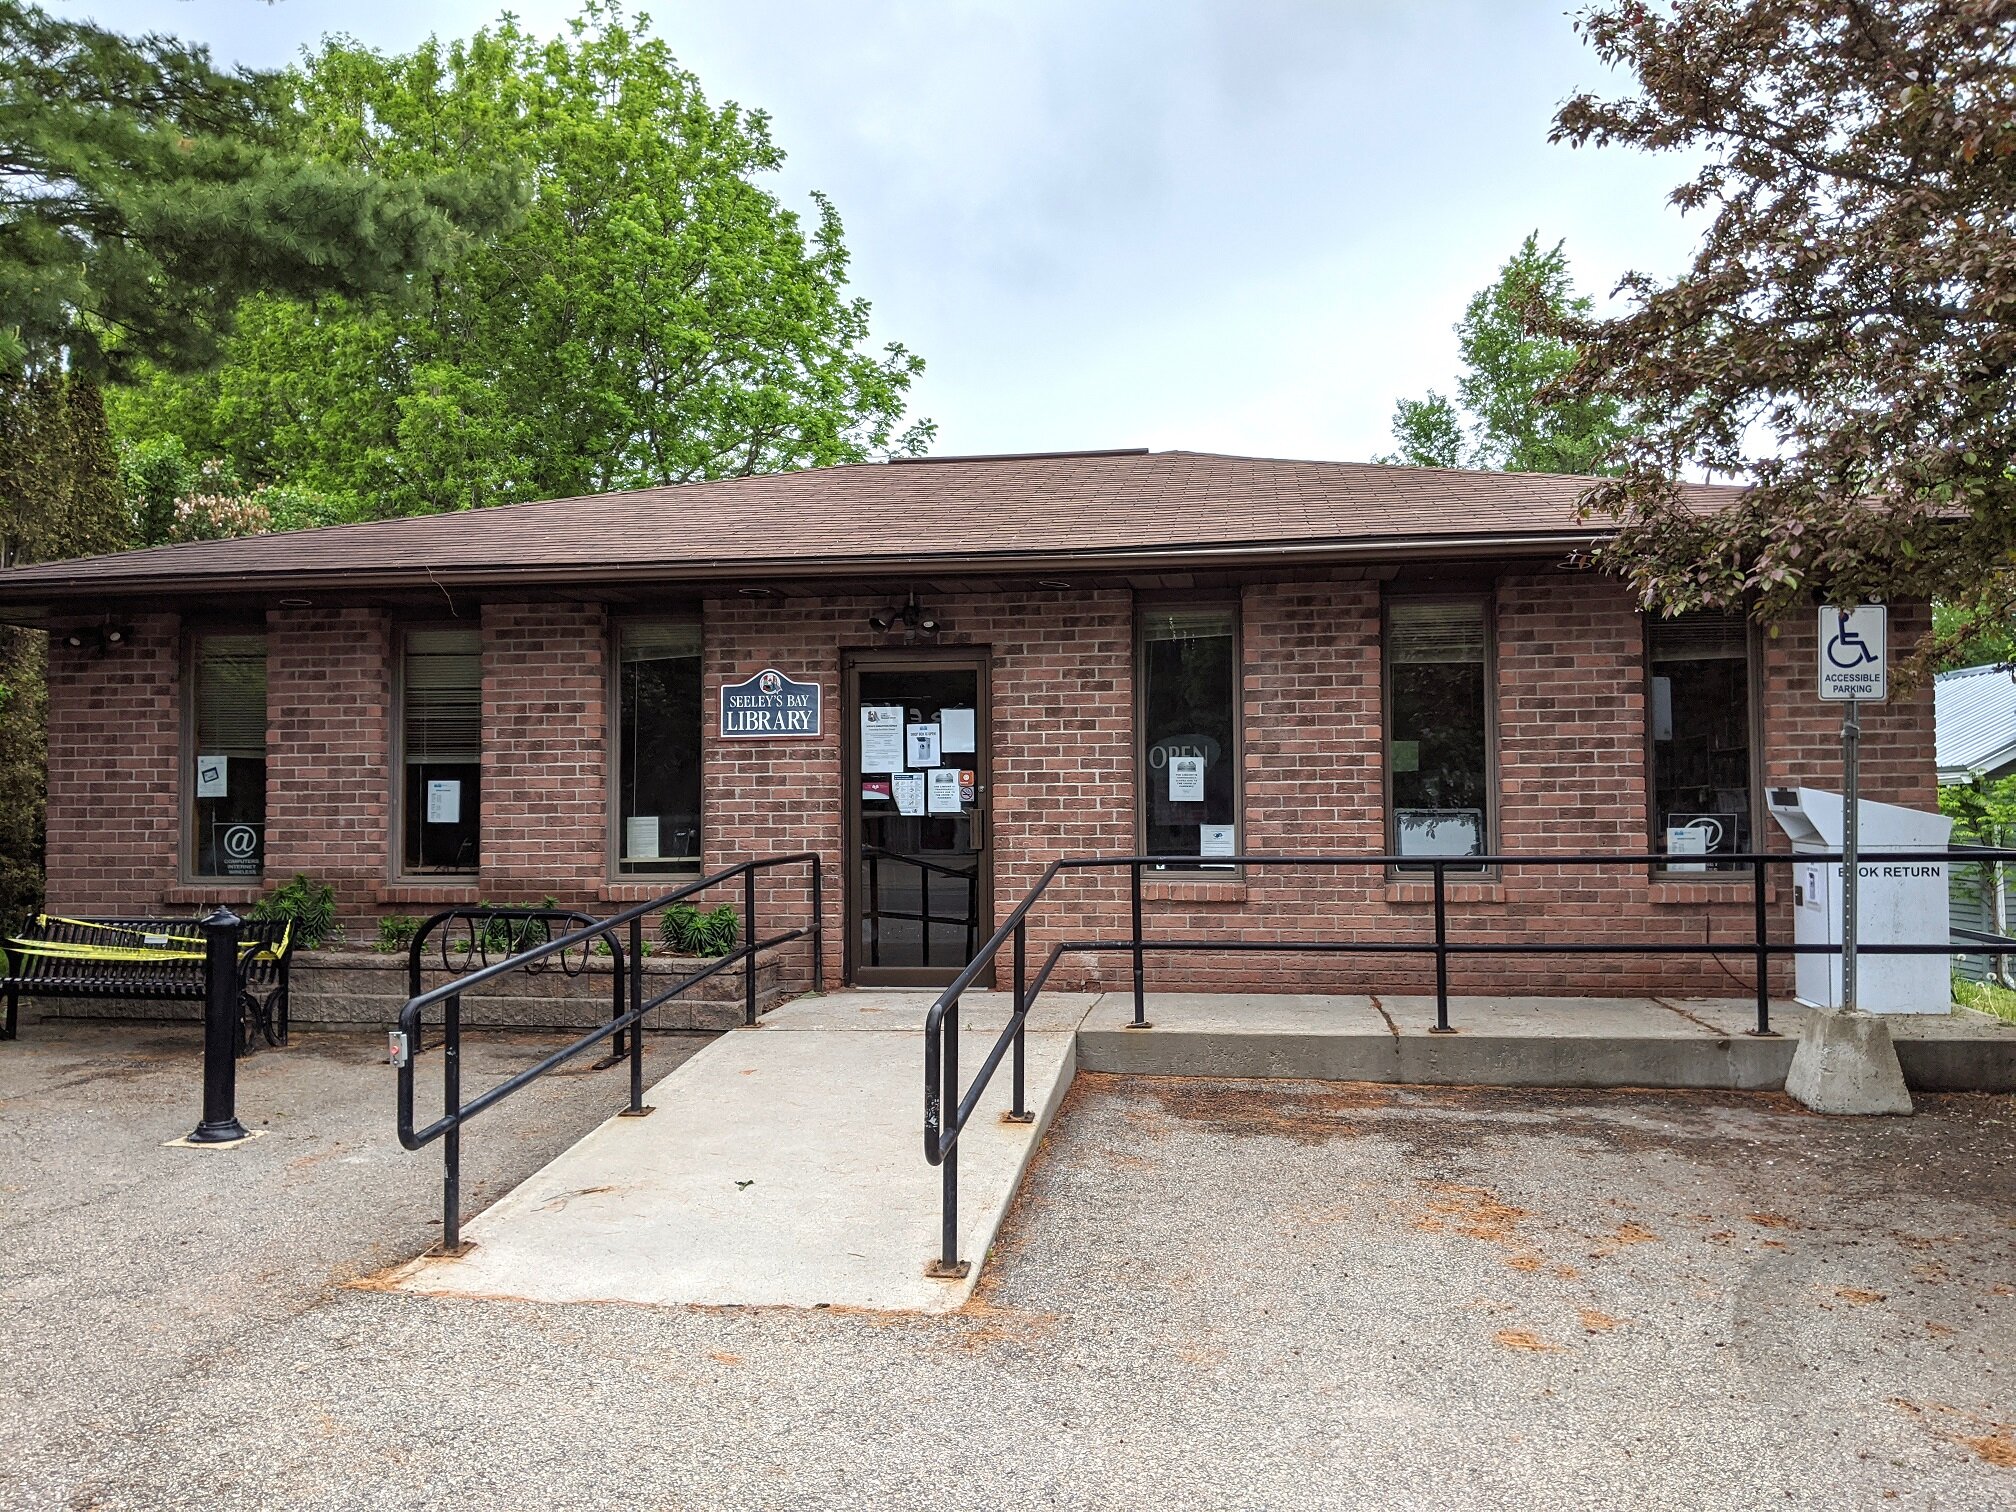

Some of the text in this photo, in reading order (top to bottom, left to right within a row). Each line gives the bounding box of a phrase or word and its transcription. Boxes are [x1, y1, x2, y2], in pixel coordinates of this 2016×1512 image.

[1825, 673, 1880, 682] ACCESSIBLE
[1833, 685, 1872, 693] PARKING
[729, 694, 810, 708] SEELEY'S BAY
[726, 710, 813, 731] LIBRARY
[1149, 745, 1208, 769] OPEN
[1883, 866, 1940, 877] RETURN
